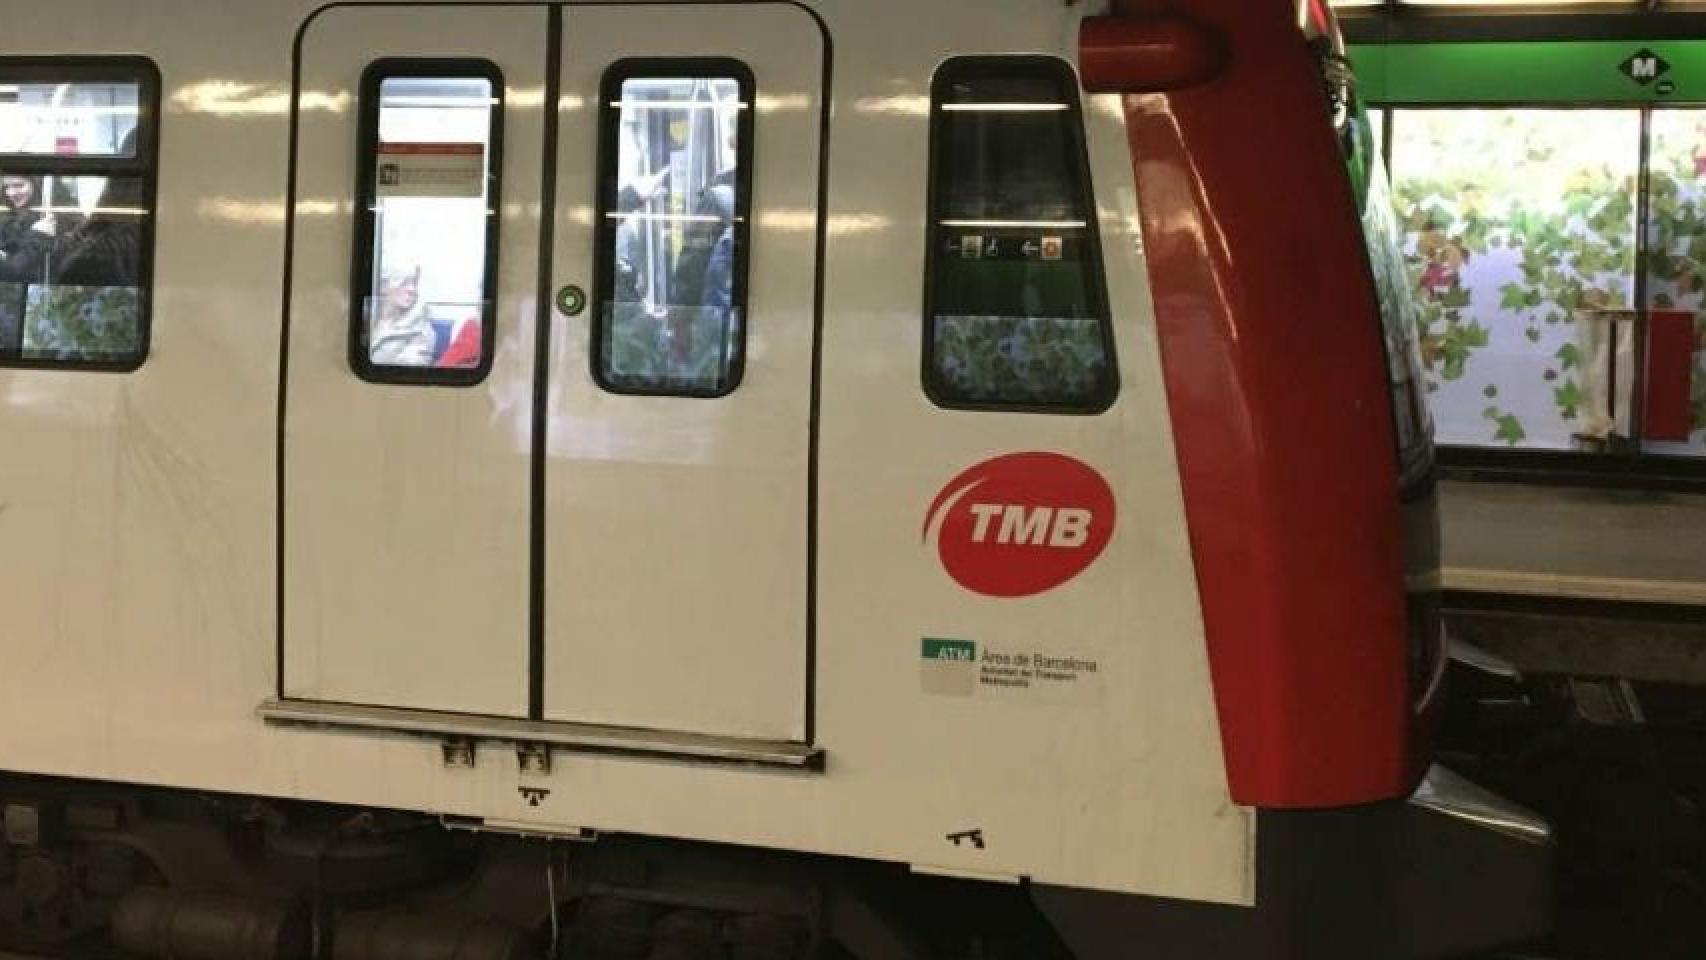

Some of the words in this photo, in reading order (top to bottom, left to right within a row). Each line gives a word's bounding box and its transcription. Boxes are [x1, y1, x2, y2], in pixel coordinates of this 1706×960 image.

[1632, 57, 1656, 76] M
[970, 503, 1093, 547] TMB
[937, 647, 971, 662] ATM
[1014, 653, 1029, 666] de
[1033, 653, 1097, 672] Barcelona
